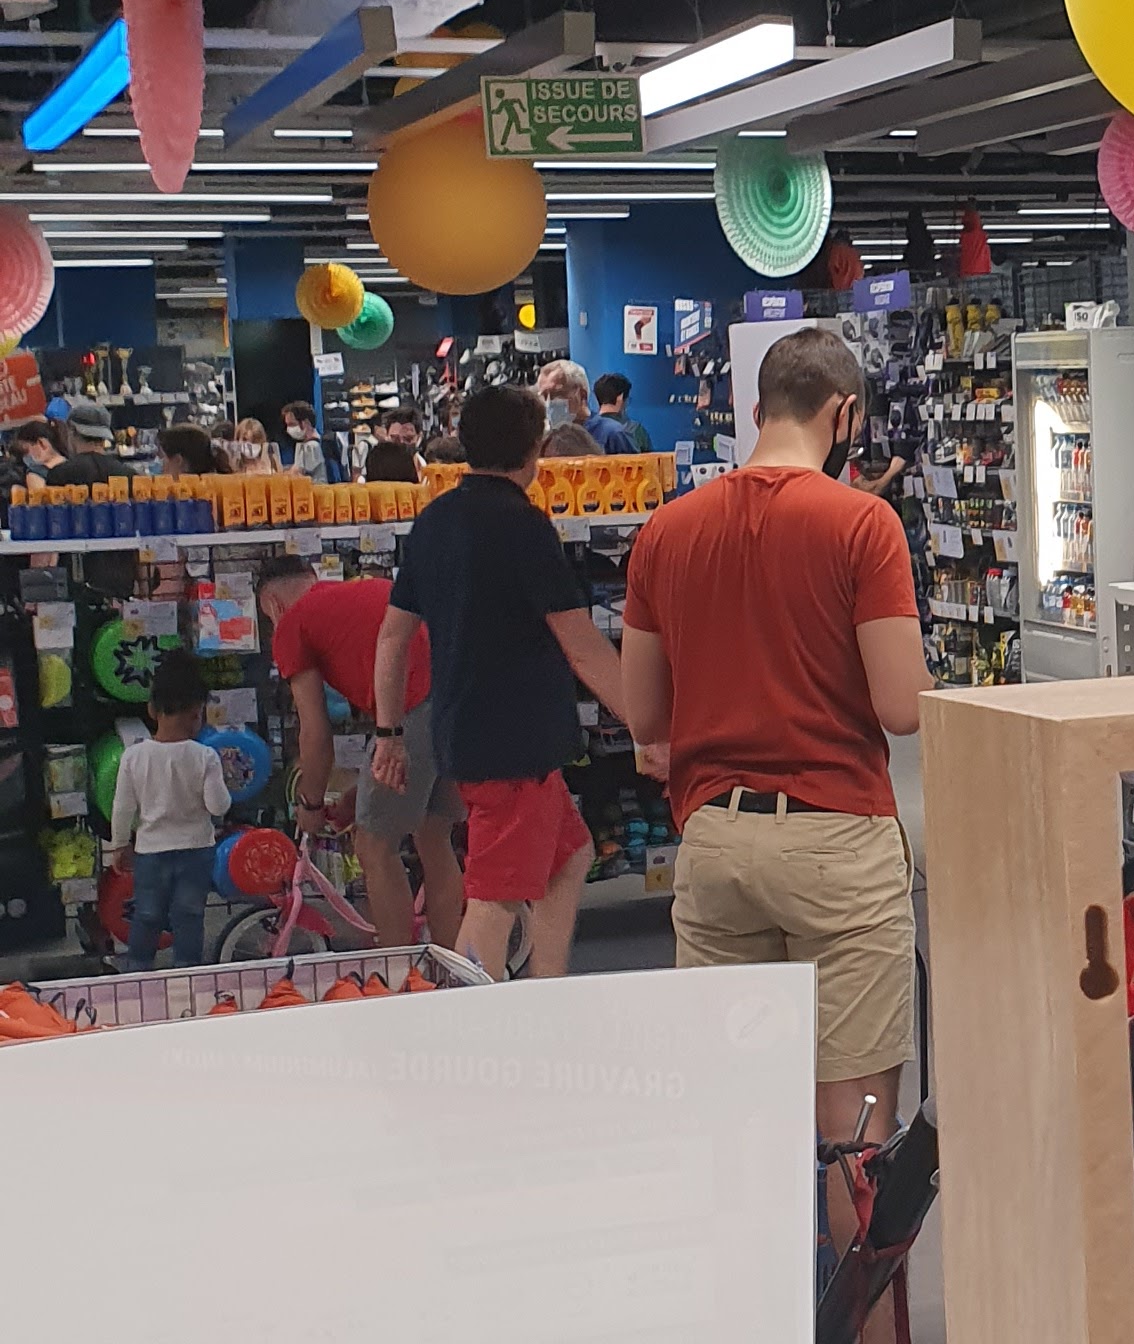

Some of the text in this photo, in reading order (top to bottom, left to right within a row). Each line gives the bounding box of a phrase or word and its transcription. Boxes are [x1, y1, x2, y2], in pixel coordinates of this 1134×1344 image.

[531, 80, 631, 100] ISSUE DE
[533, 104, 638, 123] SECOURS
